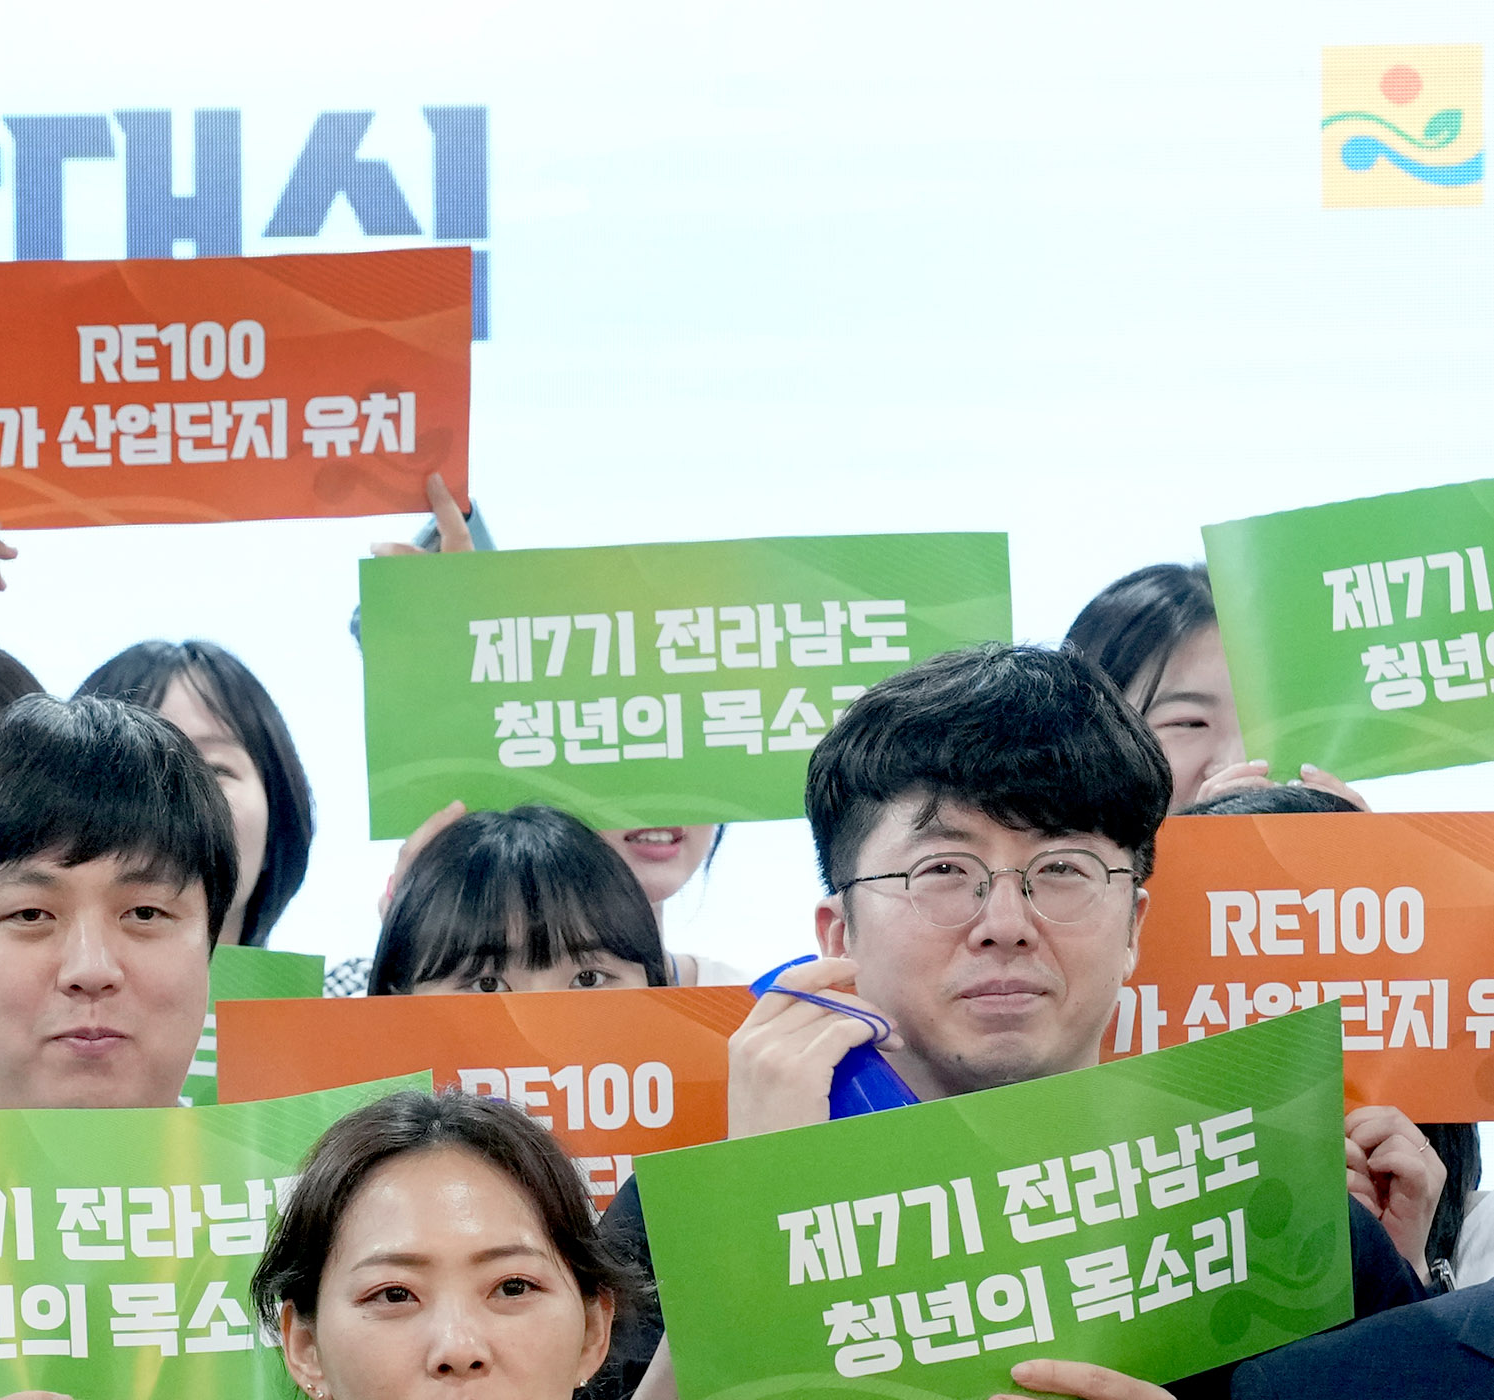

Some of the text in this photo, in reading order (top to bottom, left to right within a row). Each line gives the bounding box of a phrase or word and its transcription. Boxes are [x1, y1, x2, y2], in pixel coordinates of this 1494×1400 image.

[77, 319, 265, 383] RE100
[57, 397, 286, 467] 산업단지
[302, 392, 415, 459] 유치
[1323, 546, 1493, 632] 제7기
[468, 600, 910, 683] 제7기 전라남도
[1360, 631, 1494, 711] 청년
[493, 692, 683, 768] 청년의
[1206, 886, 1424, 957] RE100
[1113, 985, 1167, 1055] 가
[778, 1177, 983, 1286] 제7기
[996, 1107, 1260, 1245] 전라남도
[109, 1280, 283, 1358] 목소
[821, 1208, 1248, 1379] 청년의 목소리
